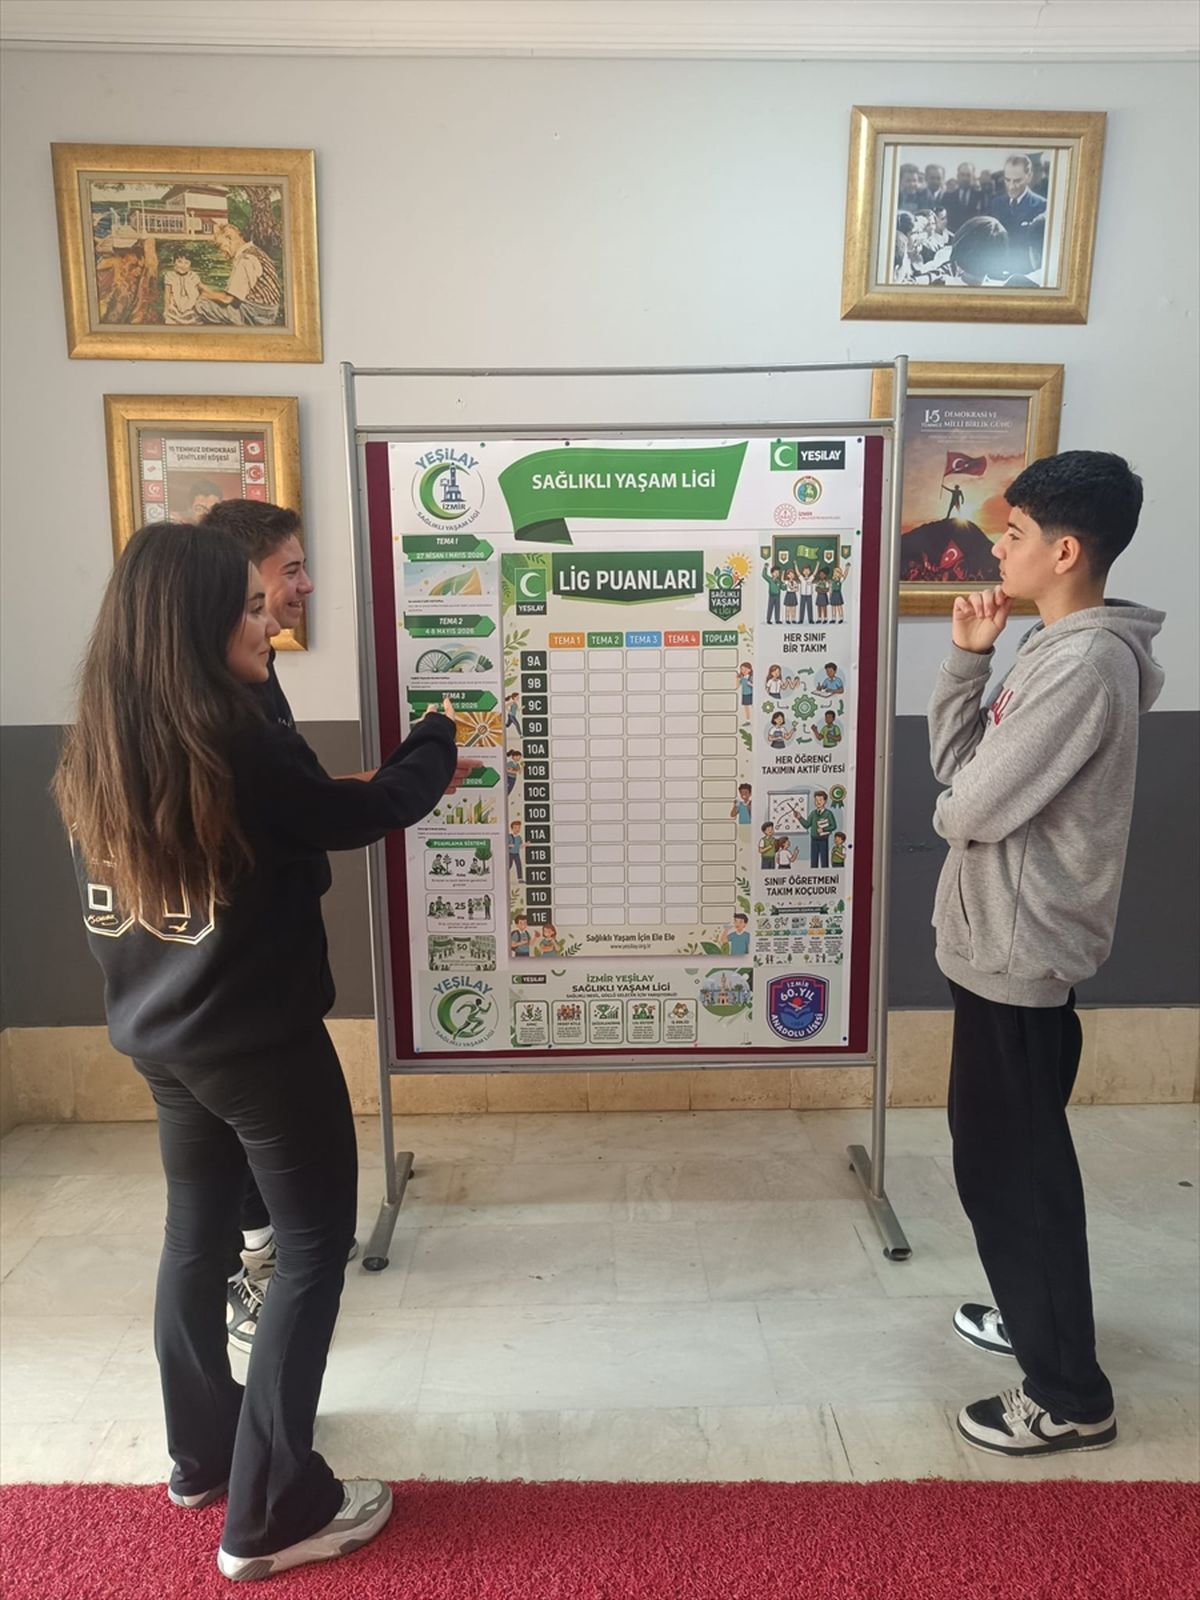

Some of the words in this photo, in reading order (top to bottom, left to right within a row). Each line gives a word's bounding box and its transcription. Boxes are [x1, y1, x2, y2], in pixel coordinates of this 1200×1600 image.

[177, 453, 207, 462] ŞEHİTLERİ
[208, 454, 230, 462] KÖŞESİ
[415, 448, 479, 470] YEŞİLAY
[800, 450, 842, 462] YEŞİLAY
[532, 471, 611, 489] SAĞLIKLI
[614, 473, 677, 492] YAŞAM
[682, 469, 716, 488] LİGİ
[442, 503, 466, 511] İZMİR
[417, 511, 445, 531] SAĞLIKLI
[445, 520, 469, 532] YAŞAM
[560, 565, 591, 590] LİG
[597, 569, 697, 590] PUANLARI
[711, 598, 740, 607] YAŞAM
[518, 604, 544, 613] YEŞİLAY
[440, 617, 458, 625] TEMA
[458, 617, 463, 625] 2
[553, 636, 575, 645] TEMA
[577, 636, 581, 645] 1
[592, 636, 611, 645] TEMA
[612, 636, 619, 644] 2
[629, 635, 649, 644] TEMA
[651, 635, 658, 644] 3
[668, 635, 688, 644] TEMA
[689, 635, 696, 643] 4
[704, 634, 736, 643] TOPLAM
[783, 633, 801, 642] HER
[804, 633, 826, 641] SINIF
[783, 643, 798, 653] BİR
[800, 643, 827, 653] TAKIM
[527, 656, 541, 667] 9A
[527, 679, 541, 689] 9B
[528, 701, 542, 711] 9C
[528, 723, 542, 733] 9D
[527, 745, 545, 754] 10A
[775, 755, 792, 764] HER
[794, 753, 832, 764] ÖĞRENCİ
[528, 766, 545, 776] 10B
[762, 765, 795, 775] TAKIMIN
[797, 764, 821, 773] AKTİF
[822, 763, 845, 773] ÜYESİ
[528, 787, 546, 797] 10C
[529, 808, 546, 818] 10D
[530, 829, 545, 839] 11A
[531, 850, 546, 860] 11B
[455, 858, 466, 867] 10
[531, 871, 546, 881] 11C
[764, 876, 787, 886] SINIF
[788, 874, 840, 886] ÖĞRETMENİ
[766, 887, 793, 896] TAKIM
[795, 886, 837, 896] KOÇUDUR
[532, 892, 547, 901] 11D
[454, 902, 466, 910] 25
[532, 912, 547, 922] 11E
[586, 933, 612, 943] Sağlıklı
[612, 933, 637, 942] Yaşam
[638, 932, 651, 942] İçin
[652, 933, 663, 941] Ele
[664, 932, 675, 941] Ele
[587, 973, 613, 983] İZMİR
[616, 972, 654, 984] YEŞİLAY
[433, 975, 493, 994] YEŞİLAY
[572, 983, 615, 992] SAĞLIKLI
[617, 984, 650, 993] YAŞAM
[653, 982, 670, 991] LİGİ
[787, 980, 809, 988] İZMİR
[771, 1013, 805, 1037] ANADOLU
[806, 1013, 824, 1034] LİSESİ
[463, 1038, 483, 1047] YAŞAM
